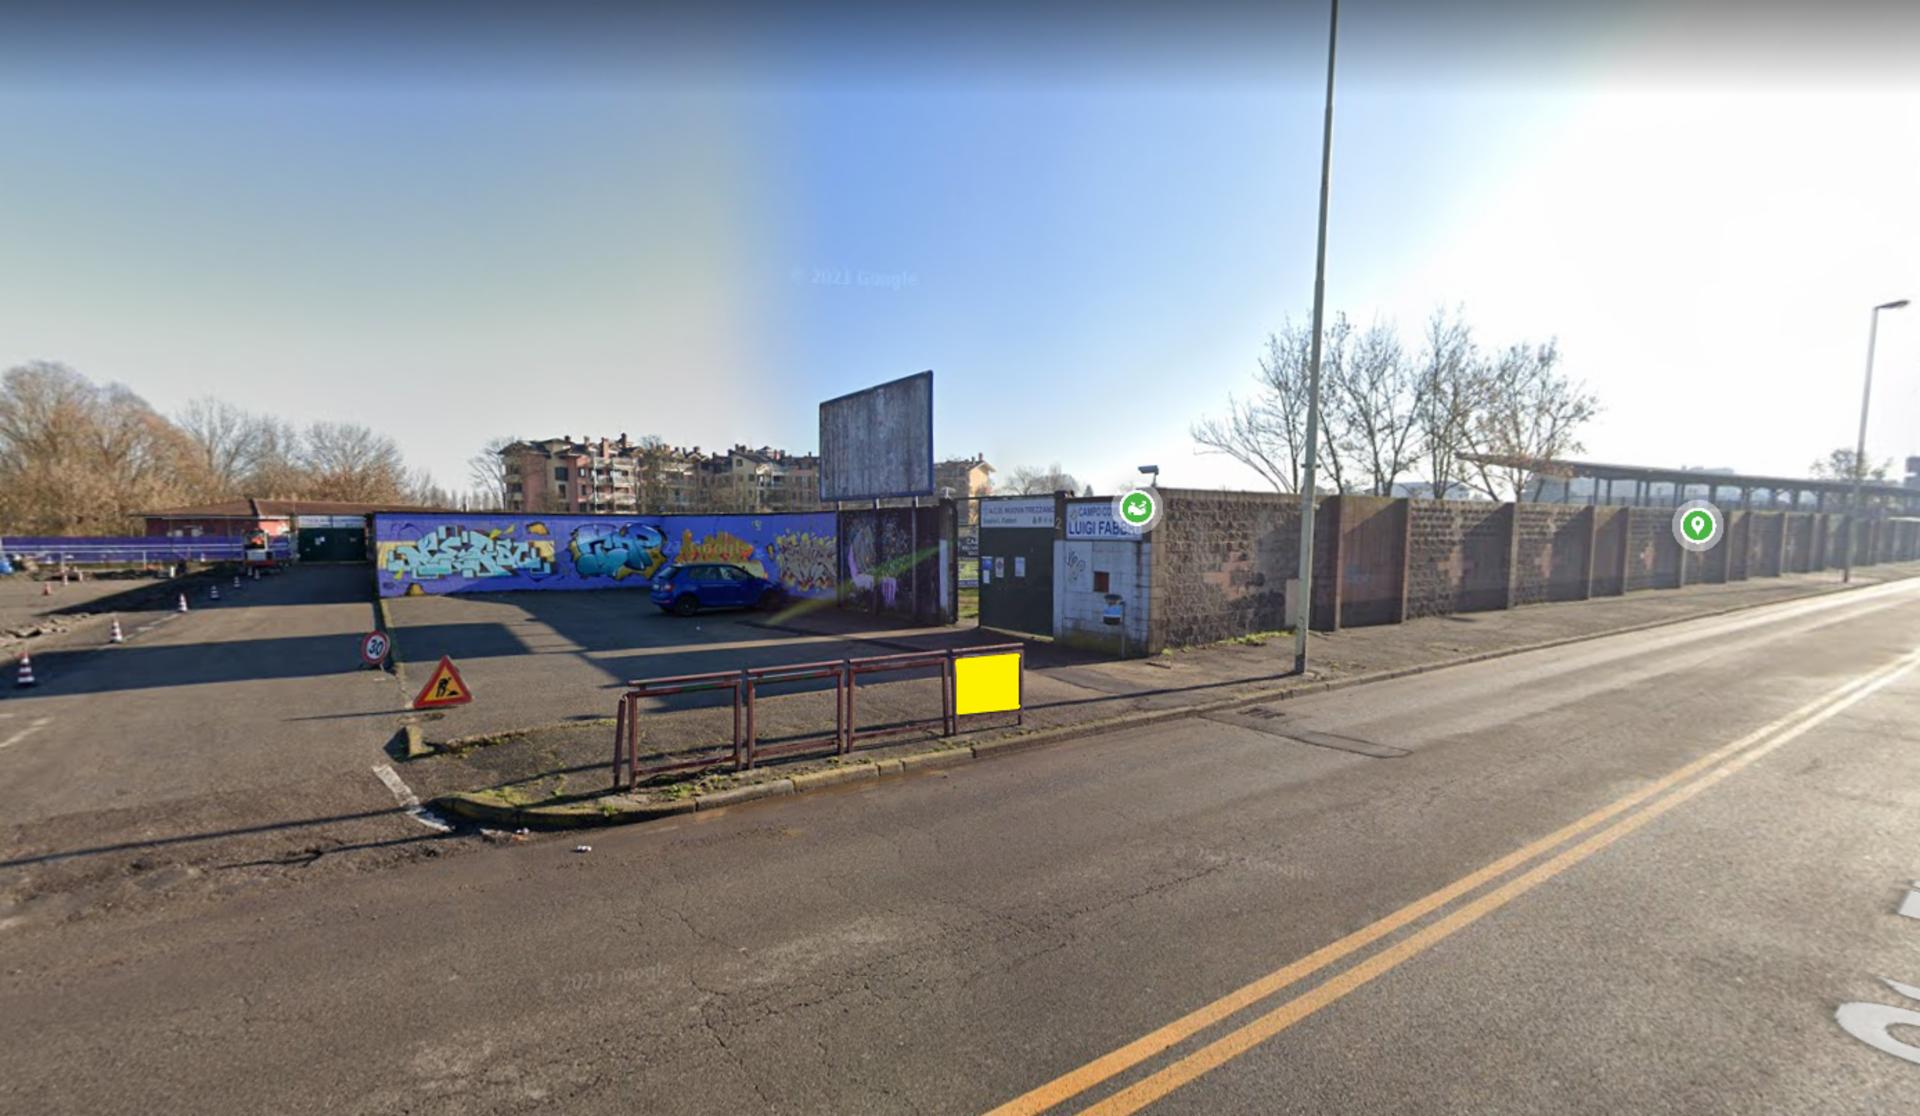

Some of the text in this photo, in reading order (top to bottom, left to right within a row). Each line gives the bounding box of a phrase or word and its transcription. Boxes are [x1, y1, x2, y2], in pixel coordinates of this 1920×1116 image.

[1079, 506, 1101, 517] CAMPO
[1068, 520, 1096, 535] LUIGI
[369, 638, 384, 656] 30
